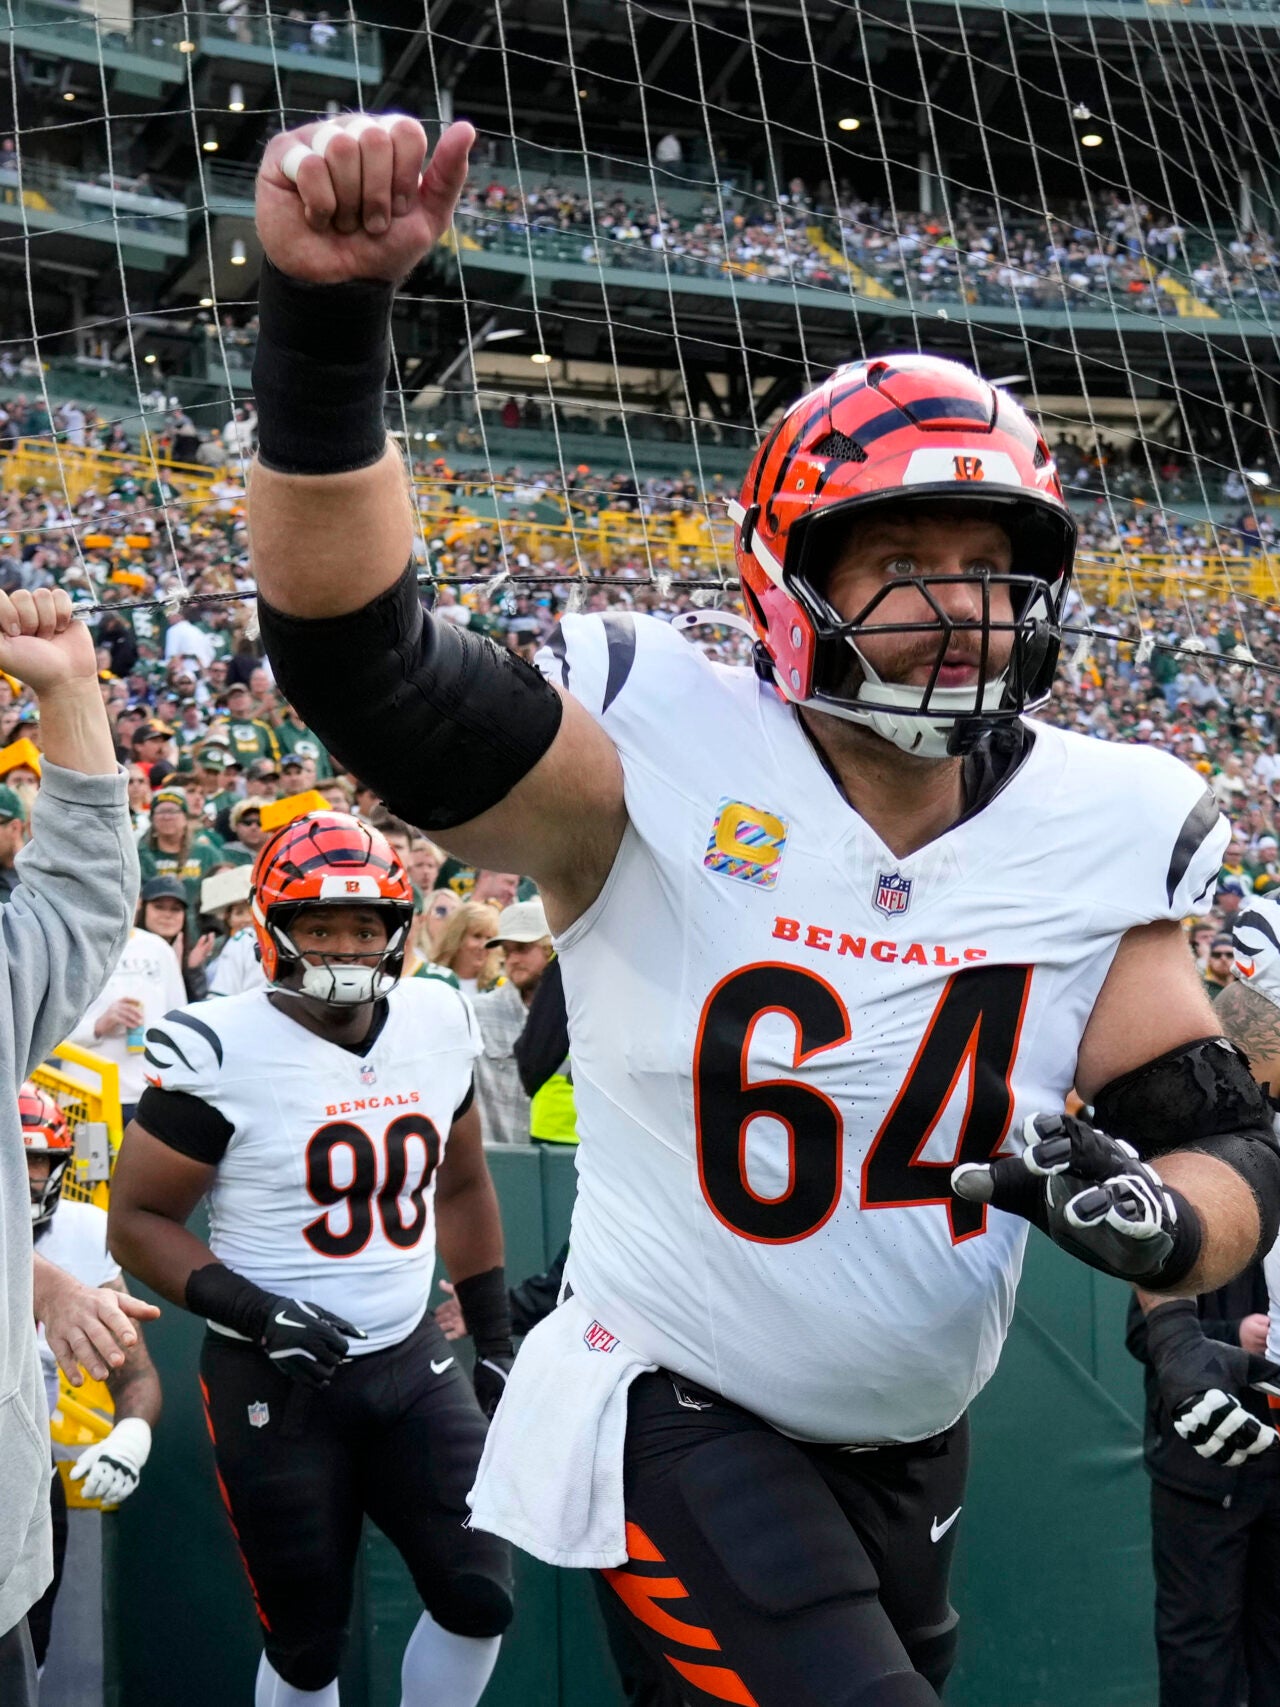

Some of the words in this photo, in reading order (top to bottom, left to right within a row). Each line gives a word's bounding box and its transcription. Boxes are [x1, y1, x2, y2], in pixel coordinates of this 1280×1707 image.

[716, 803, 784, 865] C
[879, 889, 905, 910] NFL
[772, 916, 987, 966] BENGALS
[325, 1091, 420, 1116] BENGALS
[693, 961, 1034, 1245] 64
[302, 1112, 441, 1259] 90
[586, 1323, 615, 1353] NFL
